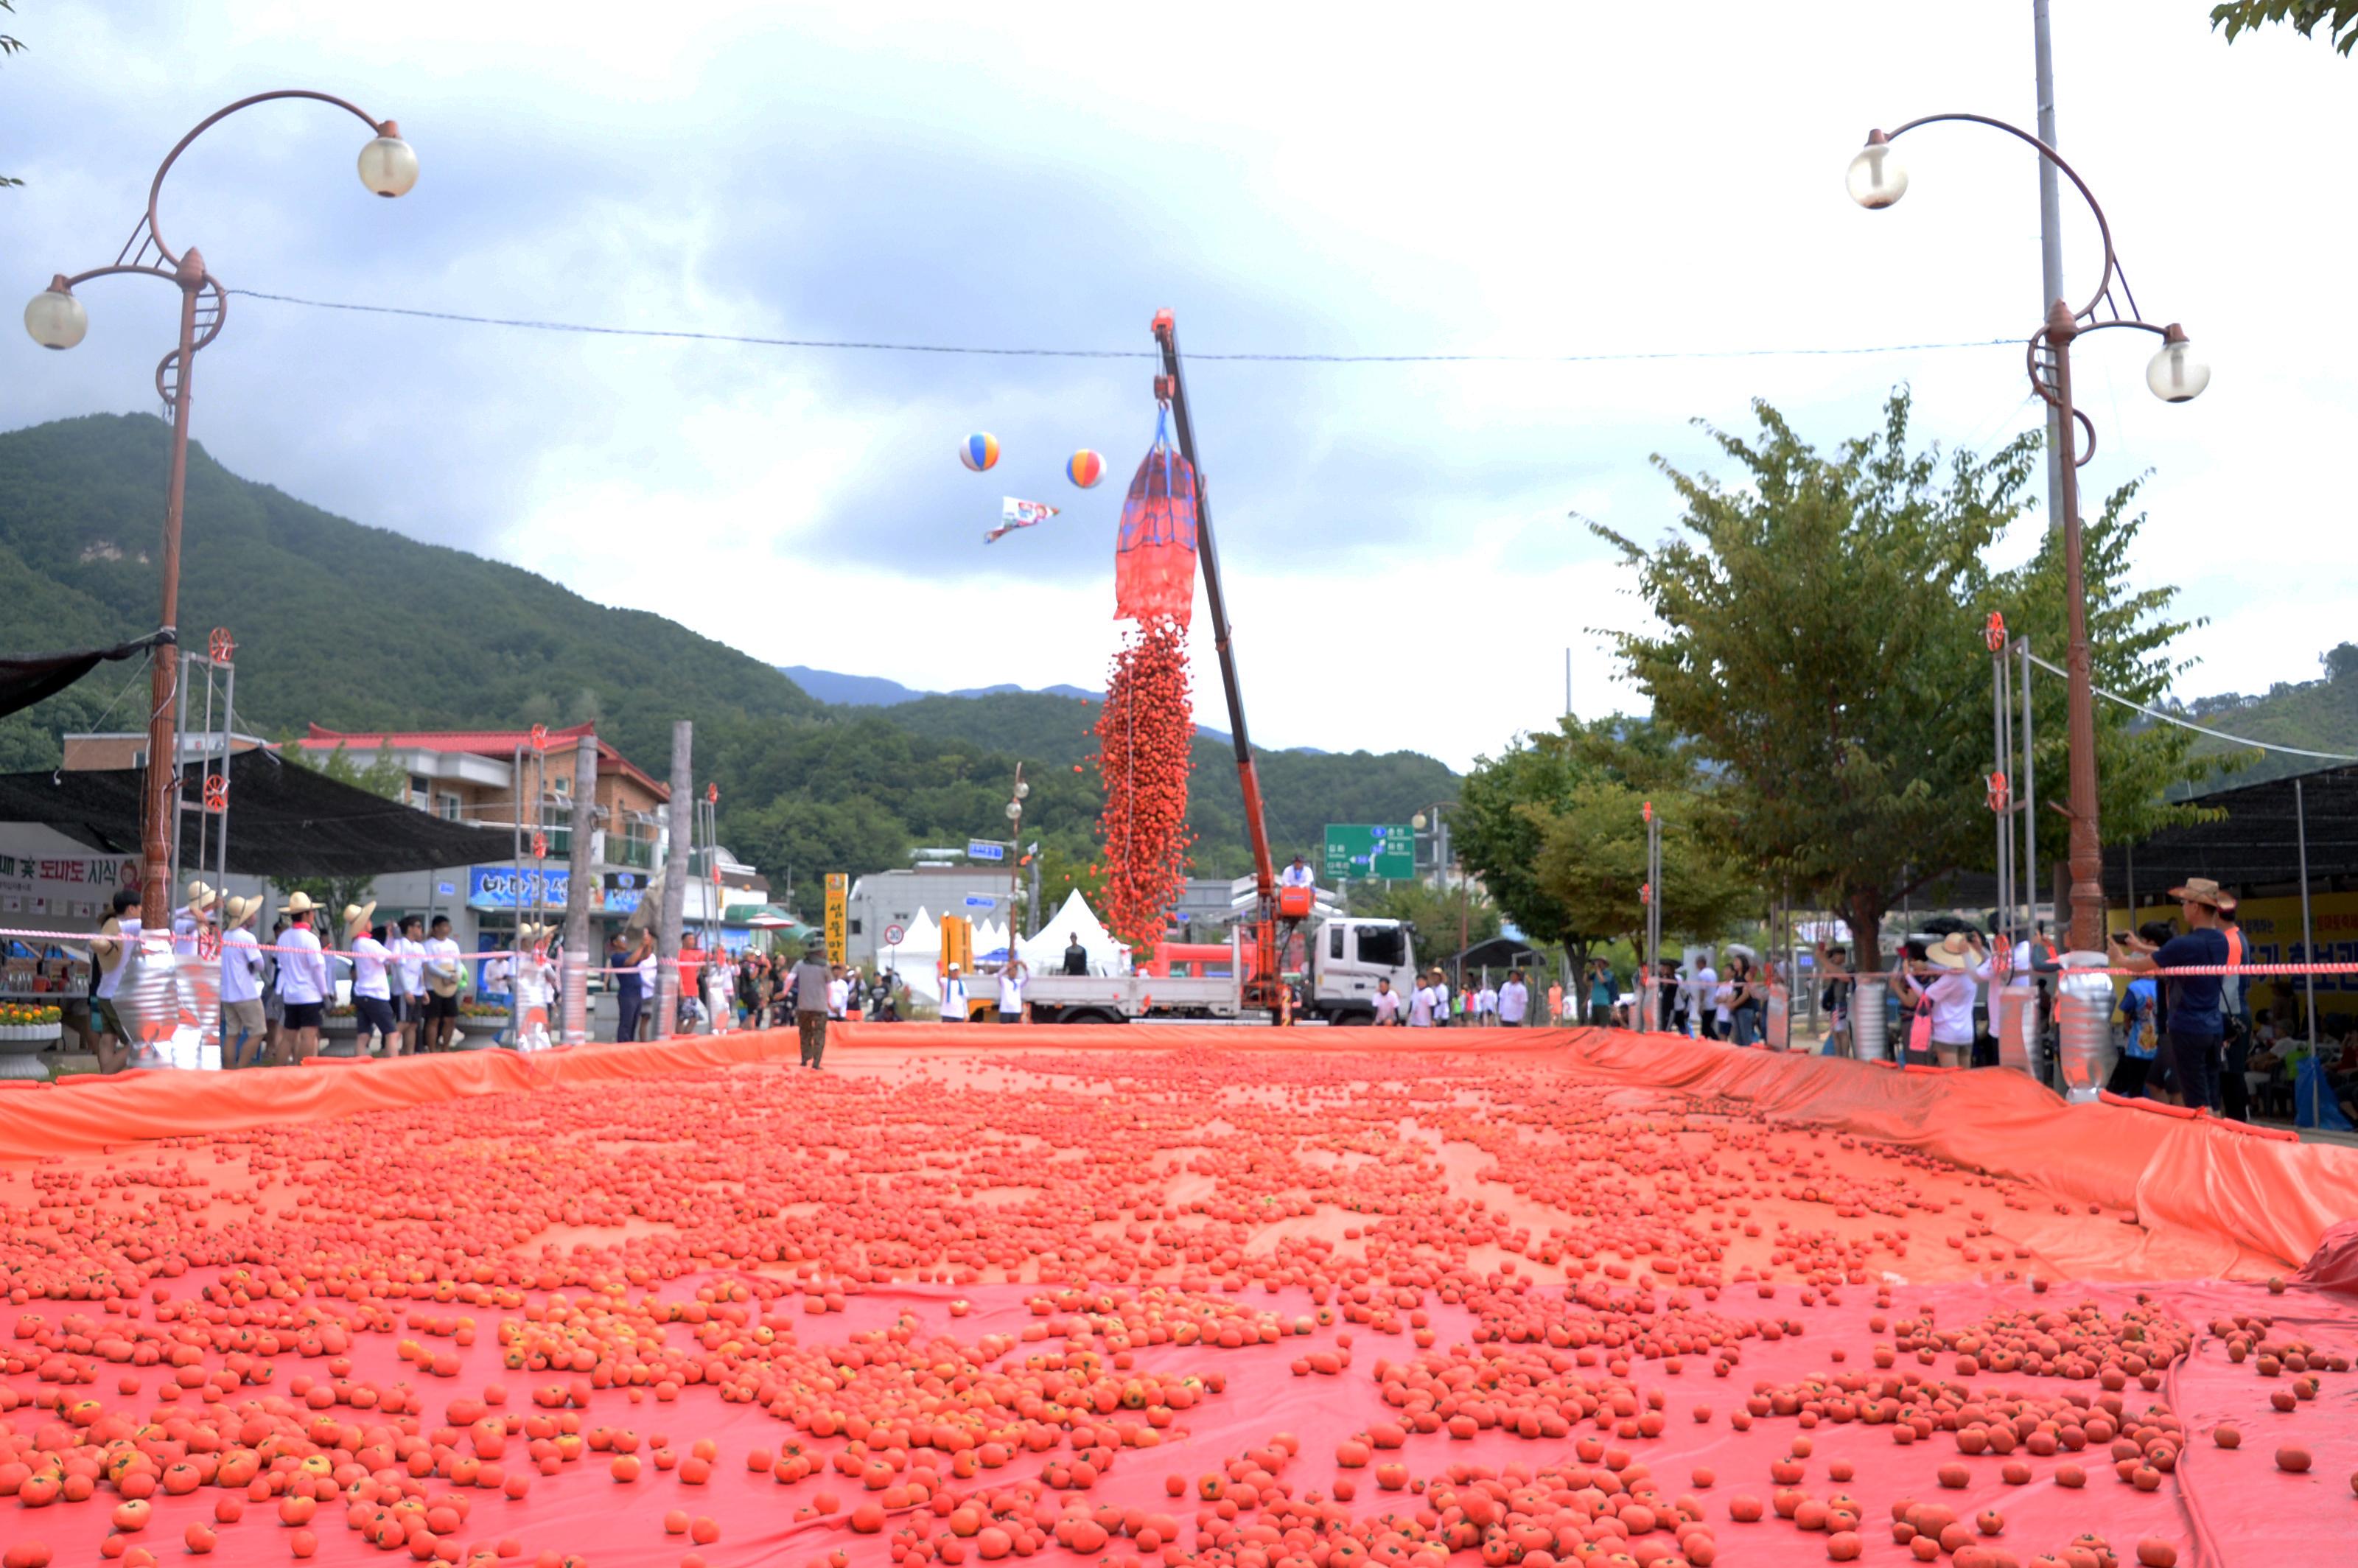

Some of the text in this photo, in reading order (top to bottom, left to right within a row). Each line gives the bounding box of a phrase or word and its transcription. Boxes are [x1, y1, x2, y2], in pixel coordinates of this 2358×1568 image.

[88, 859, 117, 886] 시식
[890, 929, 900, 939] 30
[2249, 943, 2279, 982] 기
